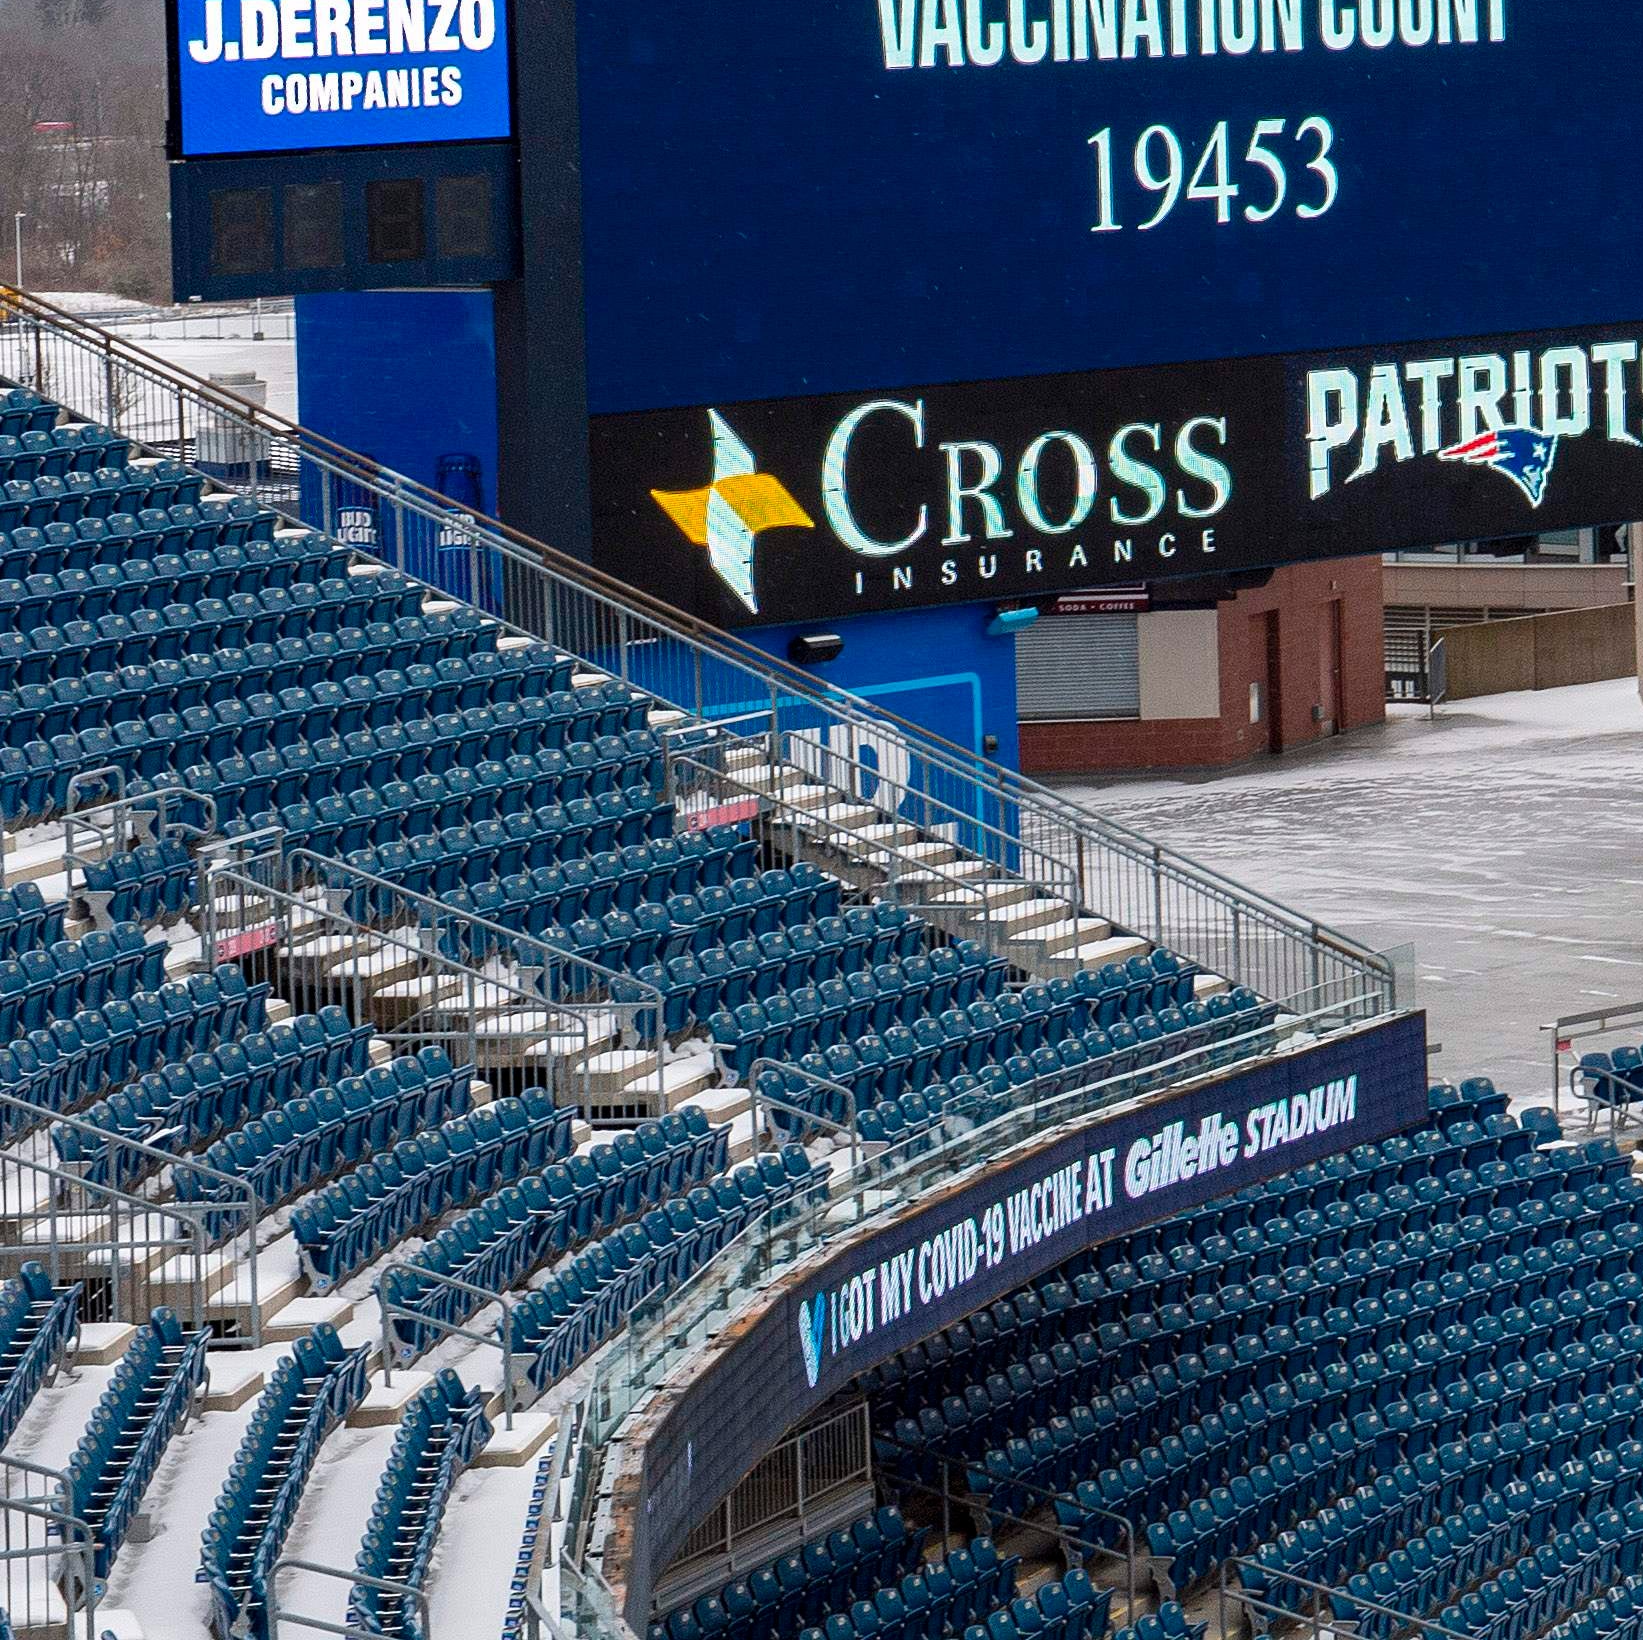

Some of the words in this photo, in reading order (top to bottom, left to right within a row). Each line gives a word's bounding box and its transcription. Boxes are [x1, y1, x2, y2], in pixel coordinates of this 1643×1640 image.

[261, 66, 462, 116] COMPANIES
[1087, 115, 1340, 233] 19453
[855, 528, 1217, 594] INSURANCE
[830, 1292, 838, 1355] I
[841, 1269, 876, 1341] GOT
[881, 1248, 916, 1327] MY
[918, 1202, 1005, 1305] COVID-19
[1005, 1160, 1083, 1256] VACCINE
[1085, 1148, 1117, 1216] AT
[1125, 1113, 1239, 1198] Gillette
[1244, 1075, 1357, 1159] STADIUM
